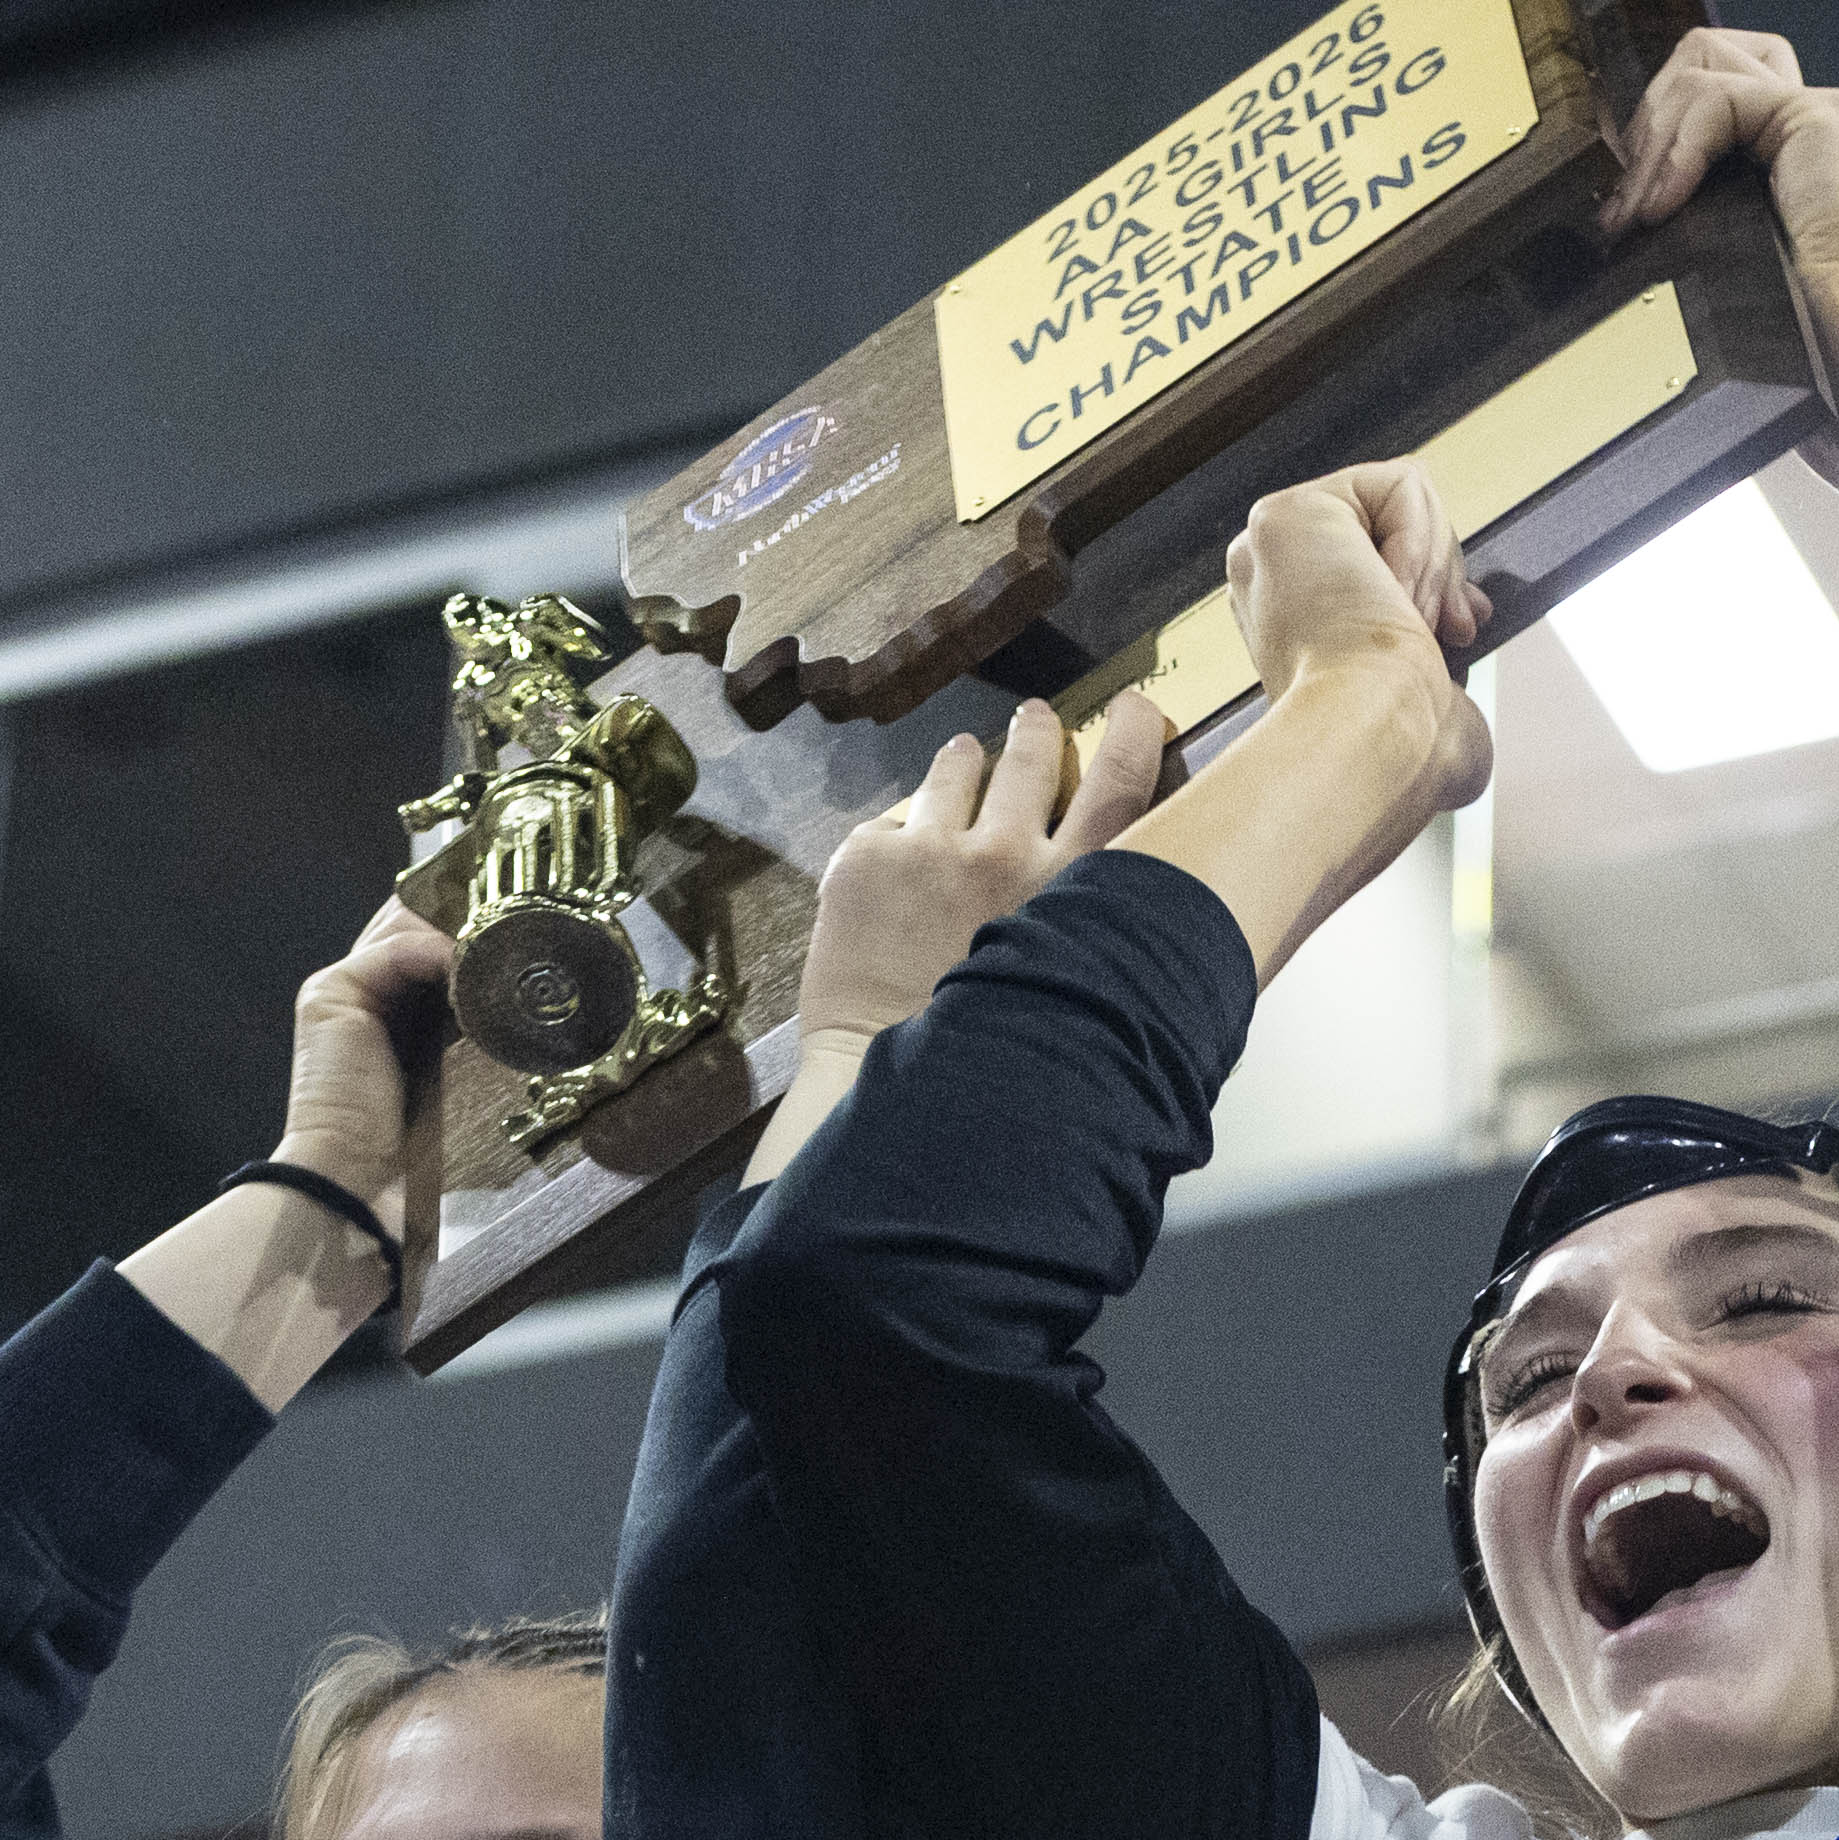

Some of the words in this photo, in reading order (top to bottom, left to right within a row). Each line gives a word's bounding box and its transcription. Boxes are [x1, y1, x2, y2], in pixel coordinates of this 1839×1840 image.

[1009, 46, 1447, 365] WRESTLING
[1046, 3, 1386, 264] 2025-2026
[1053, 217, 1153, 301] AA
[1175, 41, 1391, 207] GIRLS
[1121, 157, 1348, 336] STATE
[1015, 121, 1468, 451] CHAMPIONS
